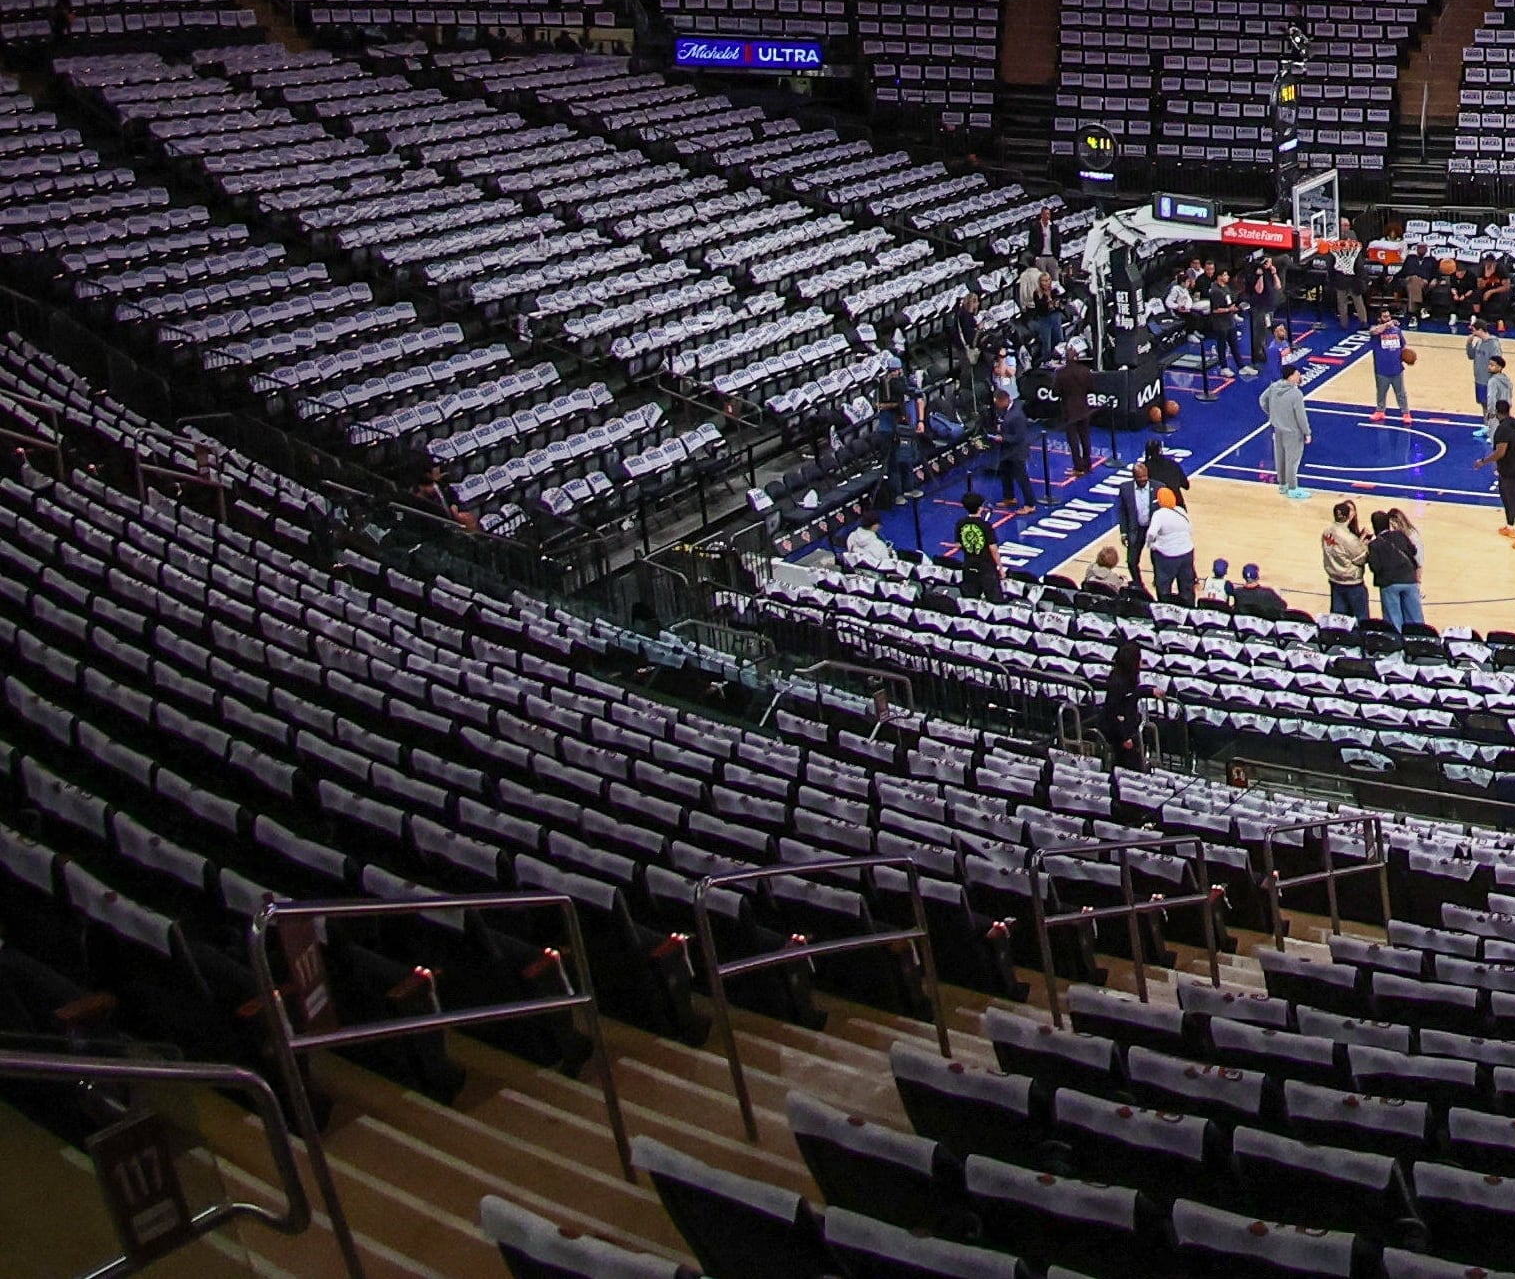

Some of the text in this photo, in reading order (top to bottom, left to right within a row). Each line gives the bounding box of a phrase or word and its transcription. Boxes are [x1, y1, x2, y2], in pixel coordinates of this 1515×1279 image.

[677, 41, 821, 64] Michelob ULTRA
[1020, 497, 1115, 539] YORK
[113, 1146, 163, 1205] 117
